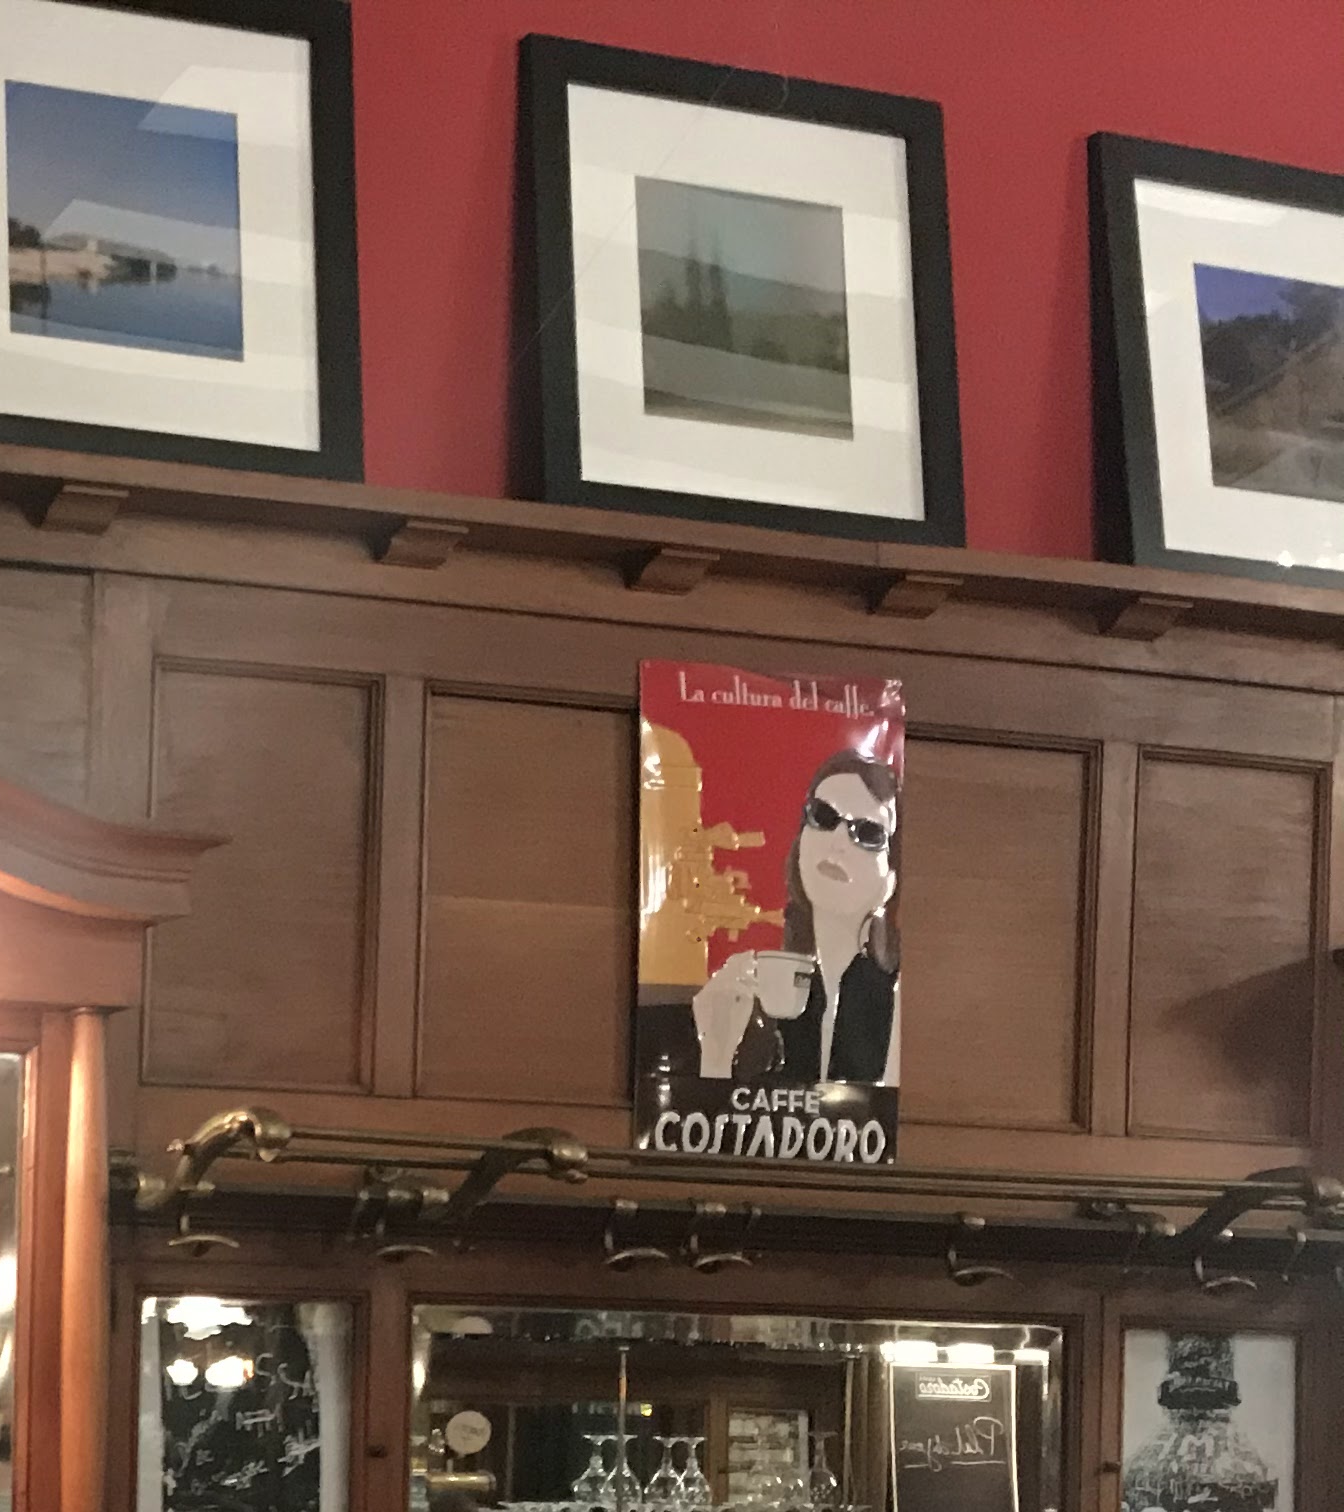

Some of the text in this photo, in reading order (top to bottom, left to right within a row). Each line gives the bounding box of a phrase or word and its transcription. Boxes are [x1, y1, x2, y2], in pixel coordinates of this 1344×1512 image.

[679, 671, 705, 703] La
[711, 675, 783, 708] cultura
[789, 679, 818, 711] del
[654, 1110, 886, 1165] COSTADORO
